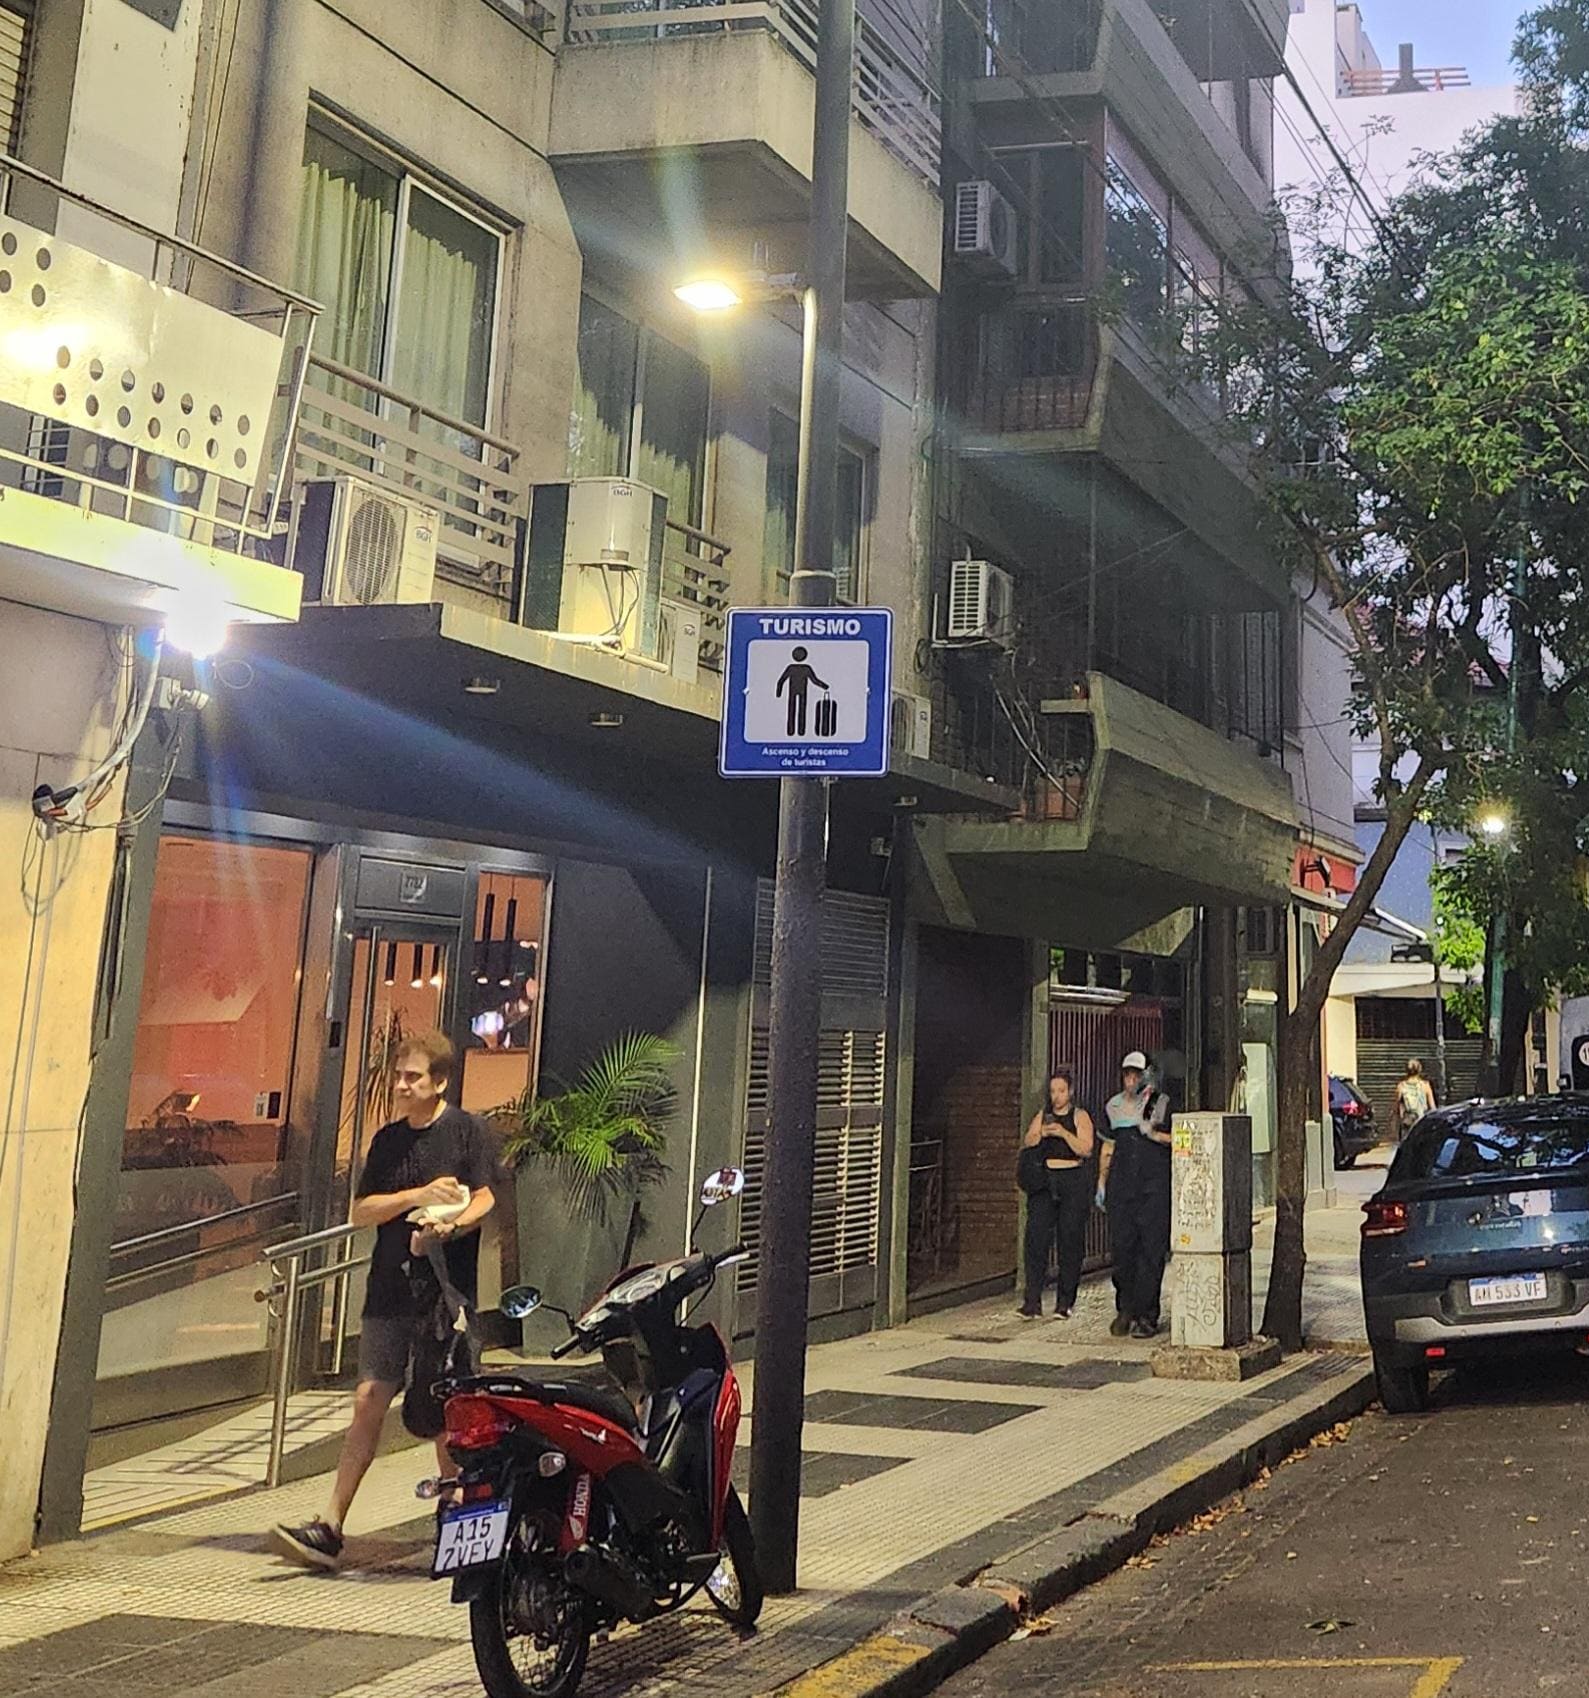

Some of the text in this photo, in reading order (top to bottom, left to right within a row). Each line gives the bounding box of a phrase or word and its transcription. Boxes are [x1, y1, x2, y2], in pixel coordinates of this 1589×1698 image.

[759, 618, 861, 636] TURISMO
[761, 747, 849, 758] Ascenso y descenso
[781, 757, 826, 767] de turistas
[1524, 1281, 1541, 1297] VF
[573, 1472, 590, 1517] HONDA
[454, 1516, 492, 1544] A15
